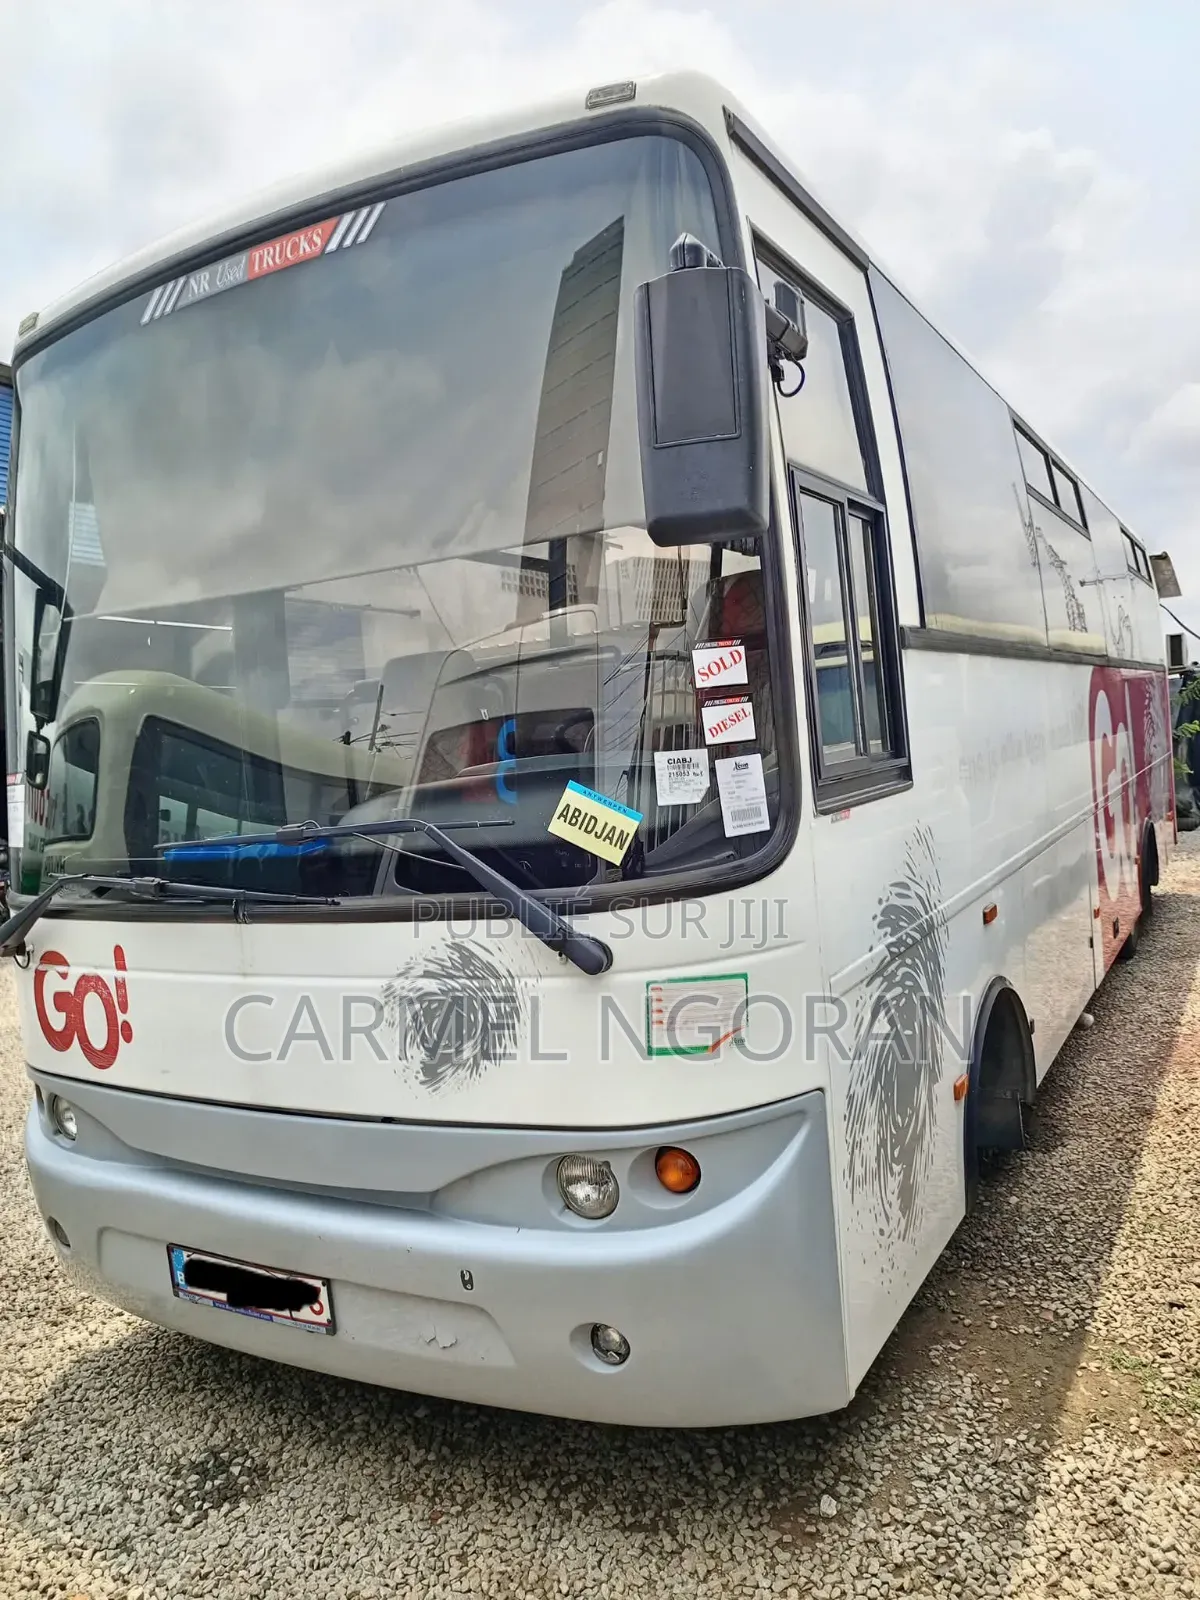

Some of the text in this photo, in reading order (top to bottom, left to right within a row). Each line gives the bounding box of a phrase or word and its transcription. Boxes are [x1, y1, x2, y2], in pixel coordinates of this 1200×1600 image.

[188, 228, 323, 299] NR Used TRUCKS
[697, 649, 743, 683] SOLD
[707, 707, 751, 739] DIESEL
[667, 757, 693, 765] CIABJ
[557, 803, 630, 851] ABIDJAN
[33, 943, 134, 1070] GO!
[178, 1271, 185, 1284] B
